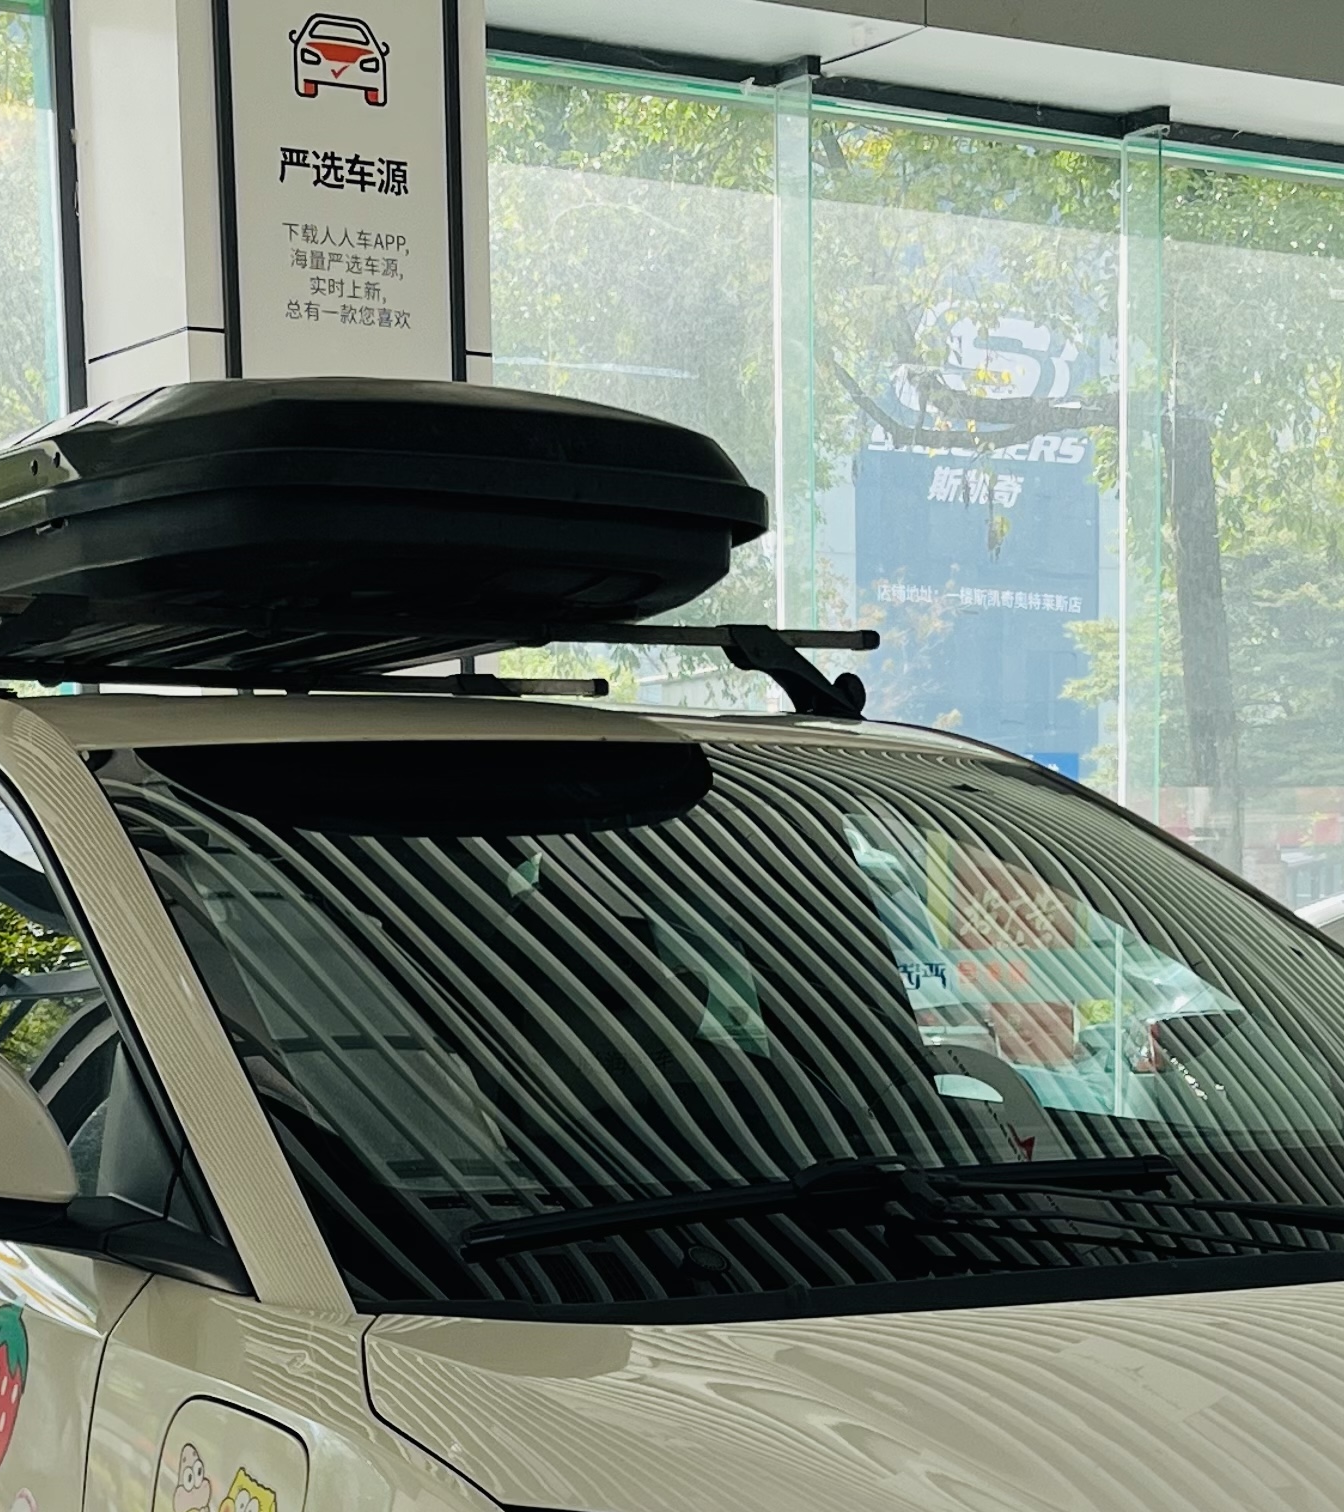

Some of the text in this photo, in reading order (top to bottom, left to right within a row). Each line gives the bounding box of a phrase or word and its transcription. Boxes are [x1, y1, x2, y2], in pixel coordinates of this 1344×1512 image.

[279, 147, 409, 196] 严选车源
[285, 299, 411, 330] 总有一款您喜欢
